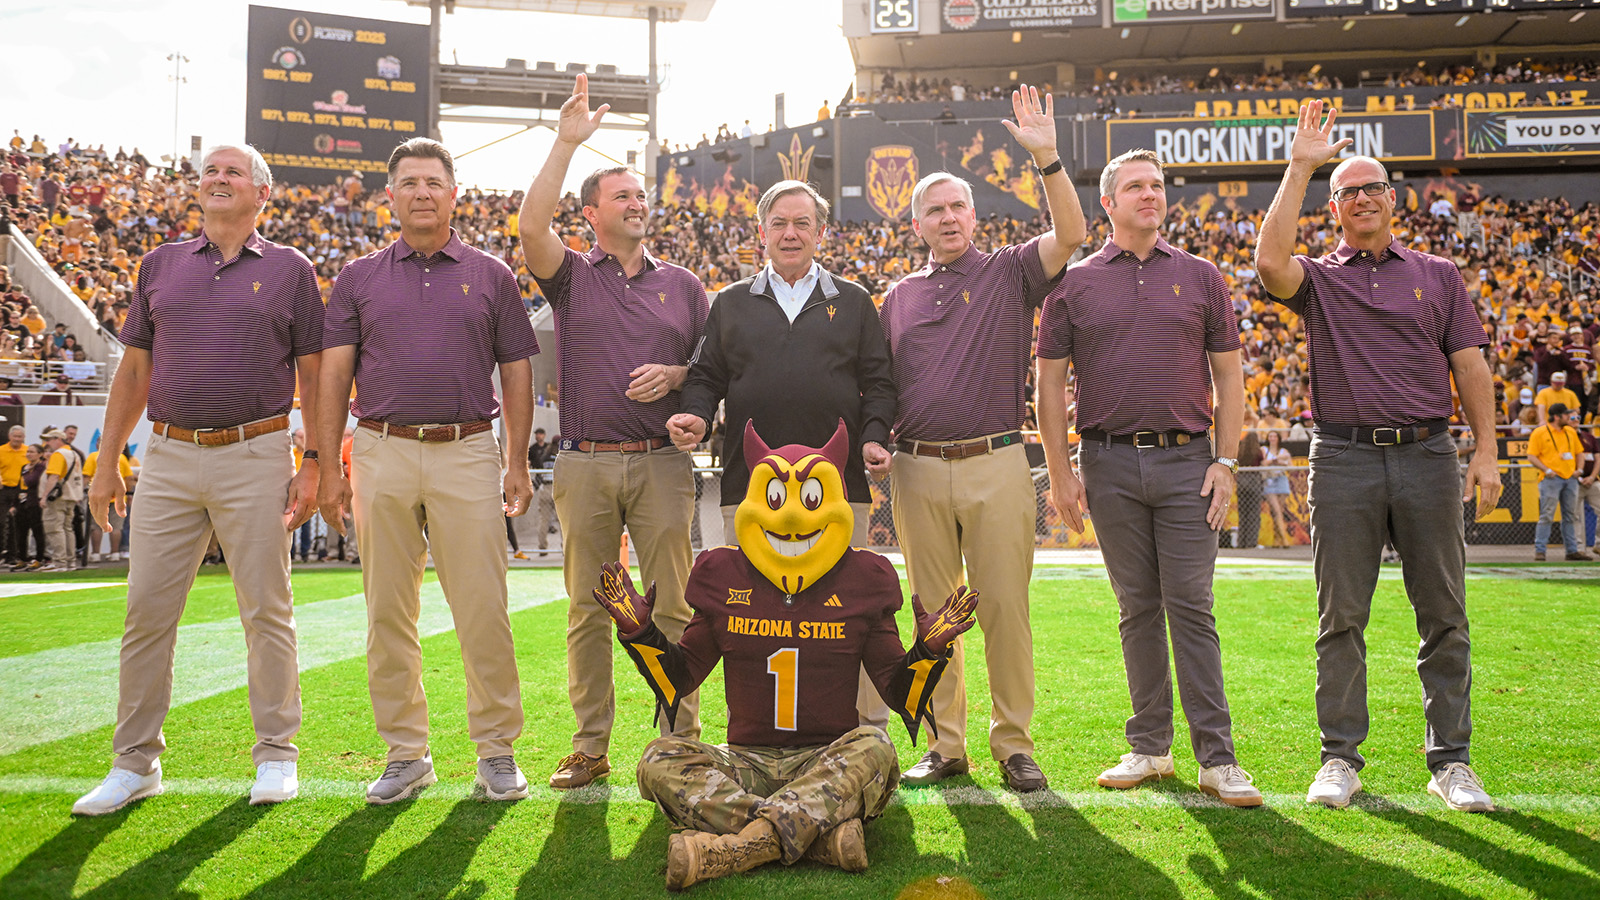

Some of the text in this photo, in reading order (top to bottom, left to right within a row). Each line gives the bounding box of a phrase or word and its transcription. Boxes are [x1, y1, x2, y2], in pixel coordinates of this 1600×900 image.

[876, 0, 912, 27] 25
[983, 5, 1097, 20] CHEESEBURGERS
[1214, 118, 1284, 128] SHAMROCK
[1515, 126, 1552, 137] YOU
[1559, 125, 1586, 136] DO
[1265, 122, 1382, 162] PRTEIN
[727, 615, 846, 639] ARIZONA STATE
[767, 648, 799, 731] 1
